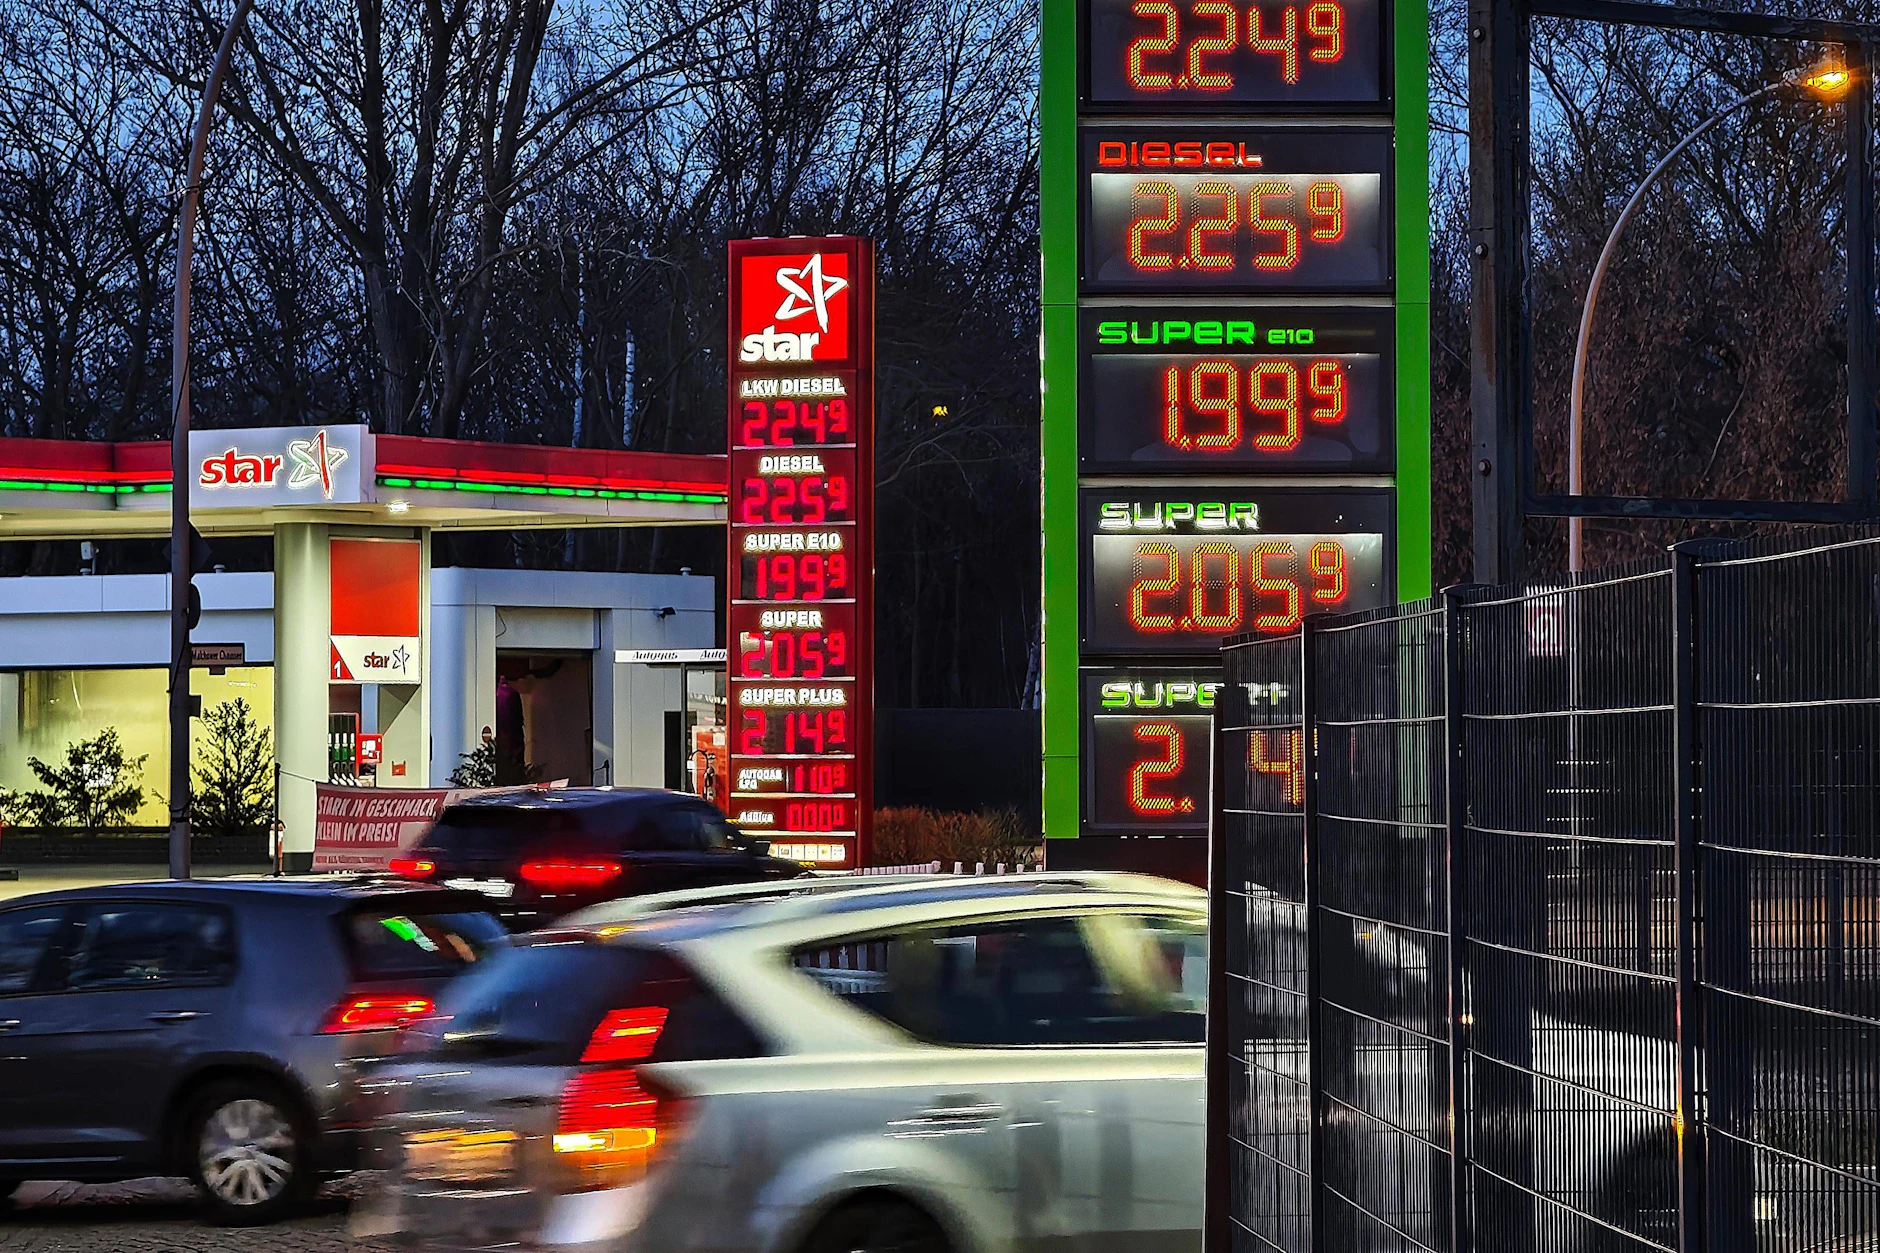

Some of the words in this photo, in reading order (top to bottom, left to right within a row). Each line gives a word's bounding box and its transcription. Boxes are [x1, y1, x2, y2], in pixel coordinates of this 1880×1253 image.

[740, 325, 820, 363] star
[742, 379, 778, 396] LKW
[780, 377, 846, 396] DIESEL
[199, 446, 284, 487] star
[760, 455, 825, 473] DIESEL
[744, 532, 805, 551] SUPER
[806, 532, 842, 551] E10
[760, 610, 823, 628] SUPER
[334, 660, 342, 678] 1
[363, 652, 390, 668] star
[740, 688, 796, 706] SUPER
[797, 687, 846, 706] PLUS
[318, 795, 350, 816] STARK
[316, 821, 342, 841] KLEIN
[343, 823, 358, 842] IM
[359, 822, 398, 842] PREIS!
